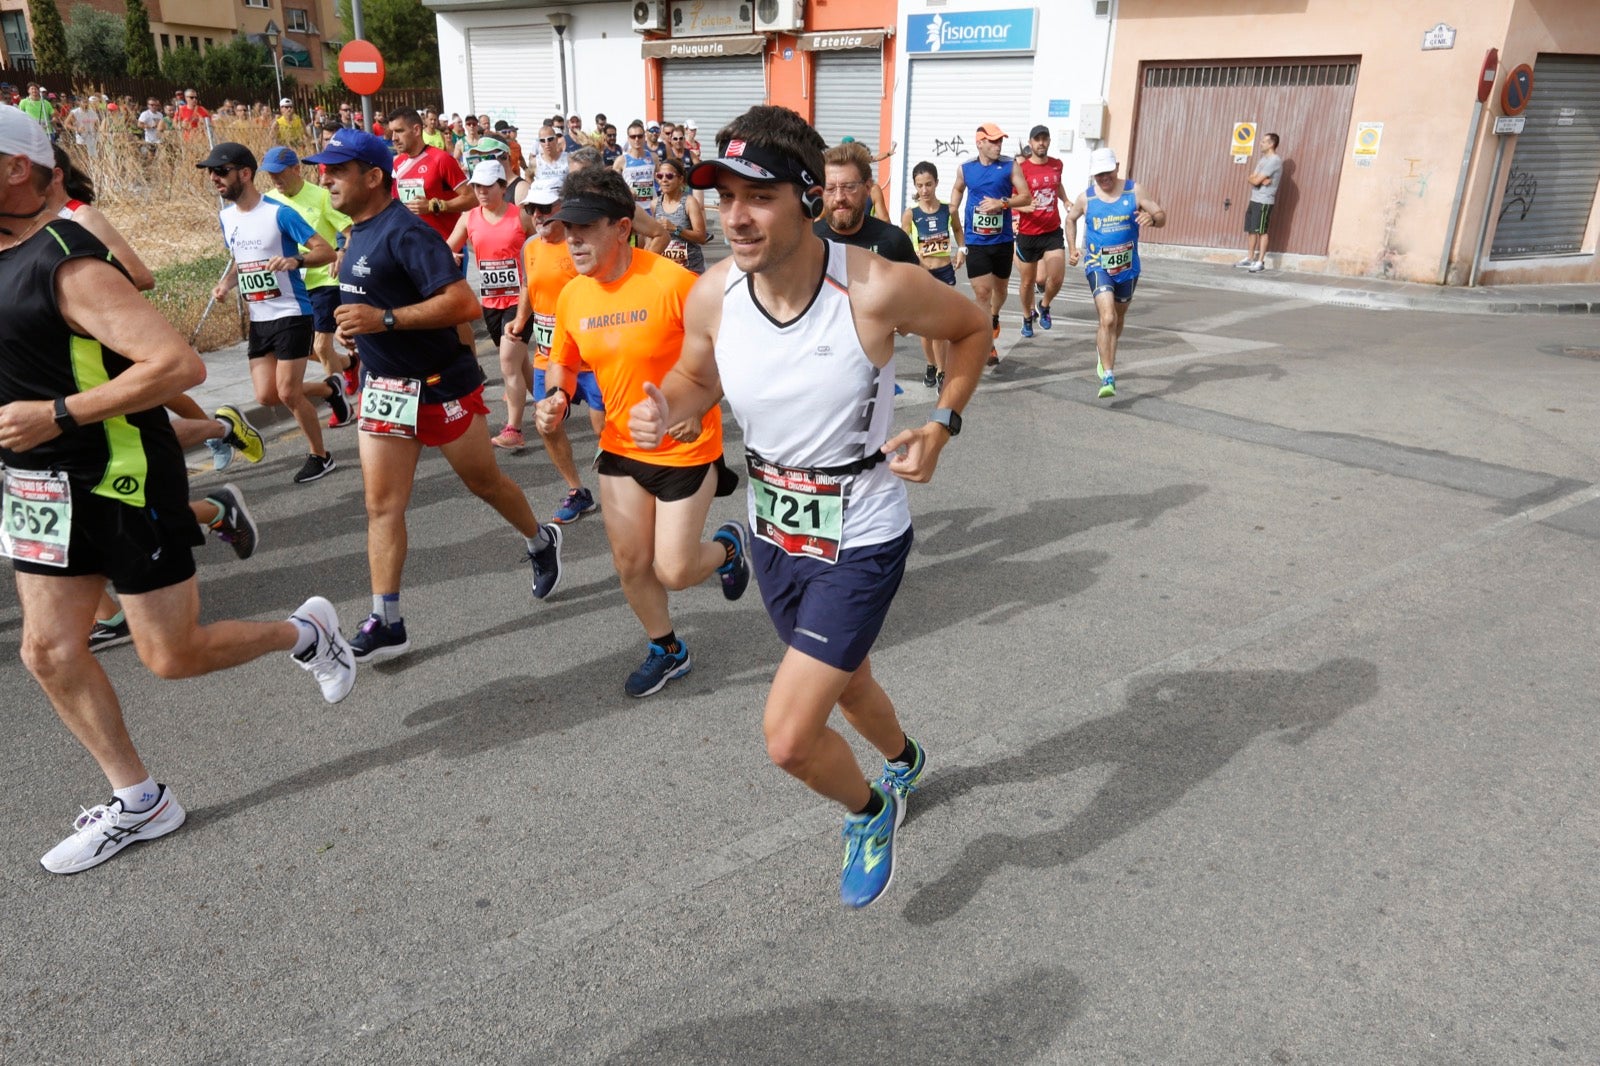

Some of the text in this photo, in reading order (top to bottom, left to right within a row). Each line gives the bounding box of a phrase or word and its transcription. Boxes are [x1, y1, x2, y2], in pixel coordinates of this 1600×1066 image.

[941, 21, 1012, 44] fisiomar
[405, 189, 416, 200] 71
[978, 215, 998, 226] 290
[1108, 252, 1128, 265] 486
[241, 272, 275, 290] 1005
[483, 271, 516, 284] 3056
[587, 309, 647, 329] MARCELINO
[365, 392, 408, 418] 357
[763, 487, 820, 529] 721
[12, 501, 58, 536] 562
